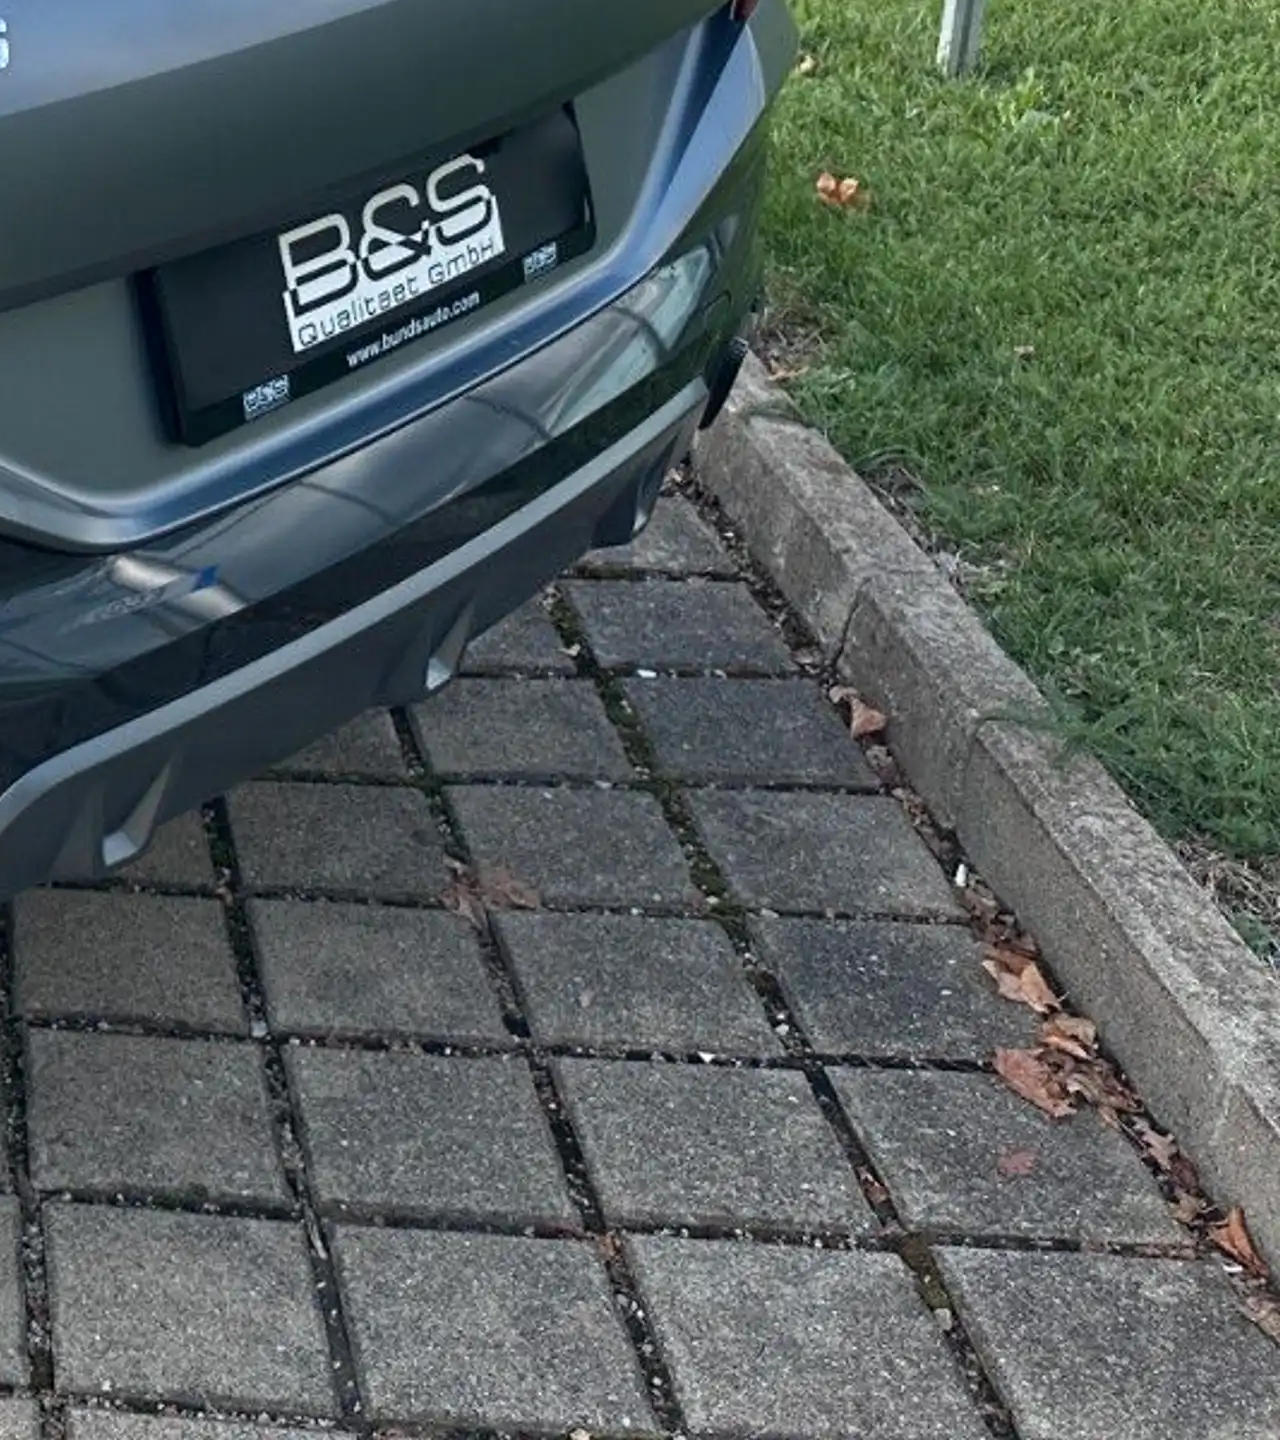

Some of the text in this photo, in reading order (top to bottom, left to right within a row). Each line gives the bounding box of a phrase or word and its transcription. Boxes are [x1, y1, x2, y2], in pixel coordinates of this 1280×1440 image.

[278, 153, 493, 318] B&S
[297, 237, 496, 347] Qualitaet GmbH
[345, 290, 481, 368] www.bundsauto.com
